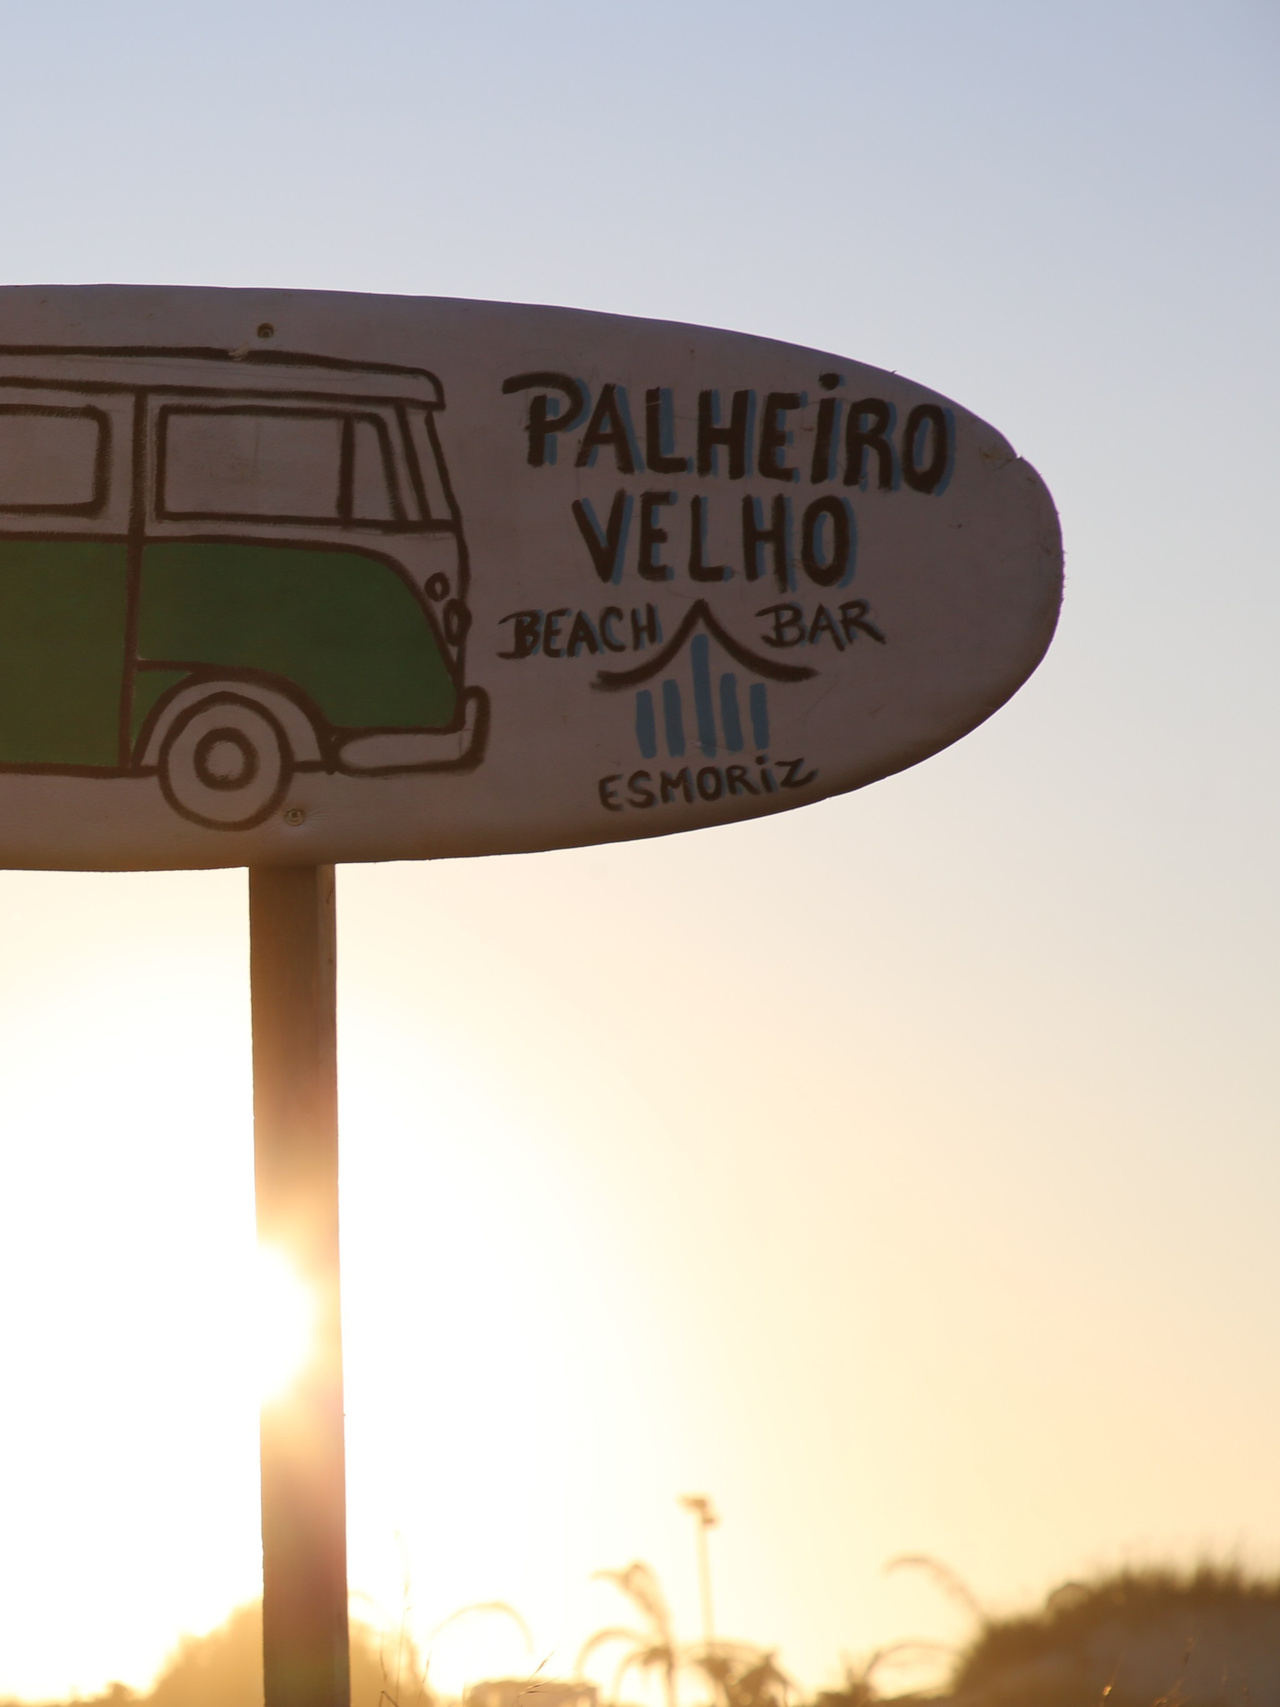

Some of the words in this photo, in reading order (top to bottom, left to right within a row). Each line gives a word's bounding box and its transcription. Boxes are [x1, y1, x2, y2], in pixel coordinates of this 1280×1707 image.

[572, 487, 857, 594] VELHO
[496, 601, 663, 660] BEACH
[755, 598, 886, 653] BAR
